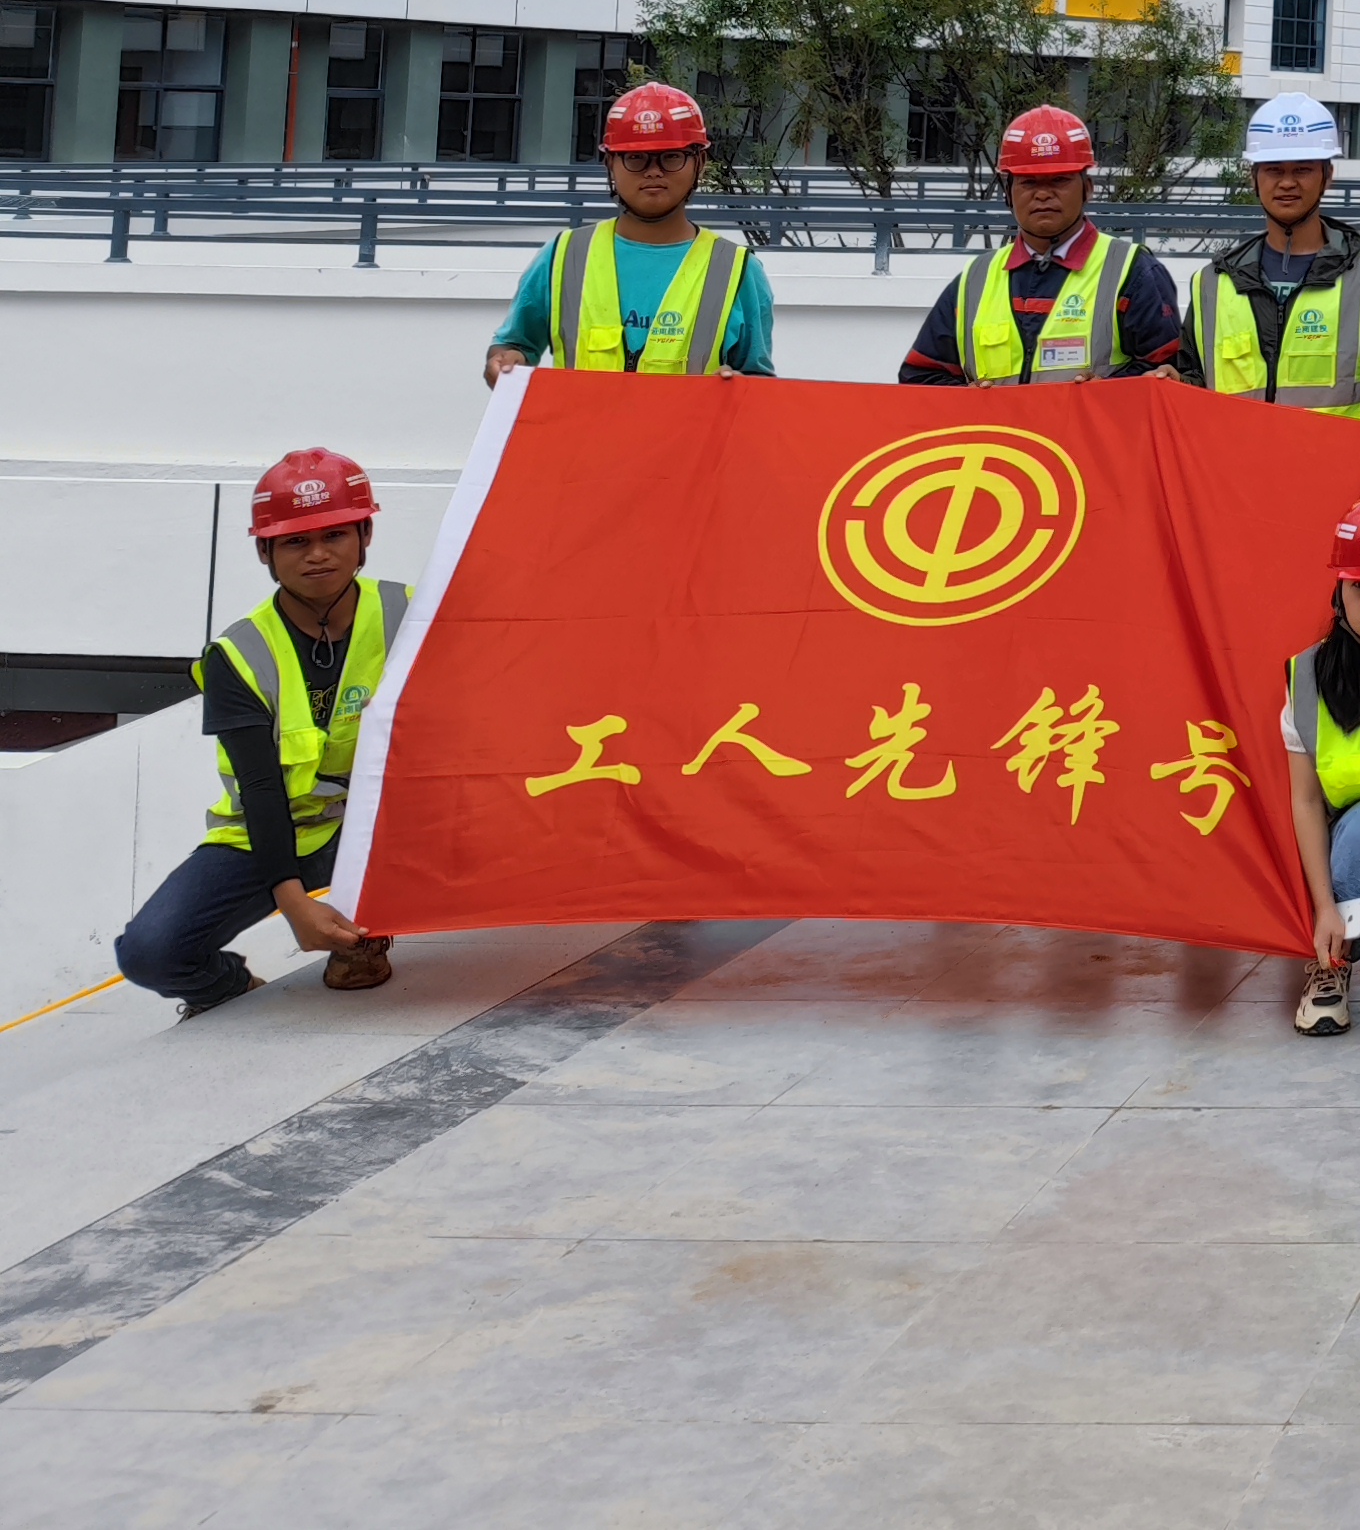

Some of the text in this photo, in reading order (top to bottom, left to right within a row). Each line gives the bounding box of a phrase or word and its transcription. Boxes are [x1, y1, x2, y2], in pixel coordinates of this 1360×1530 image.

[525, 683, 1251, 836] 工人先锋号
